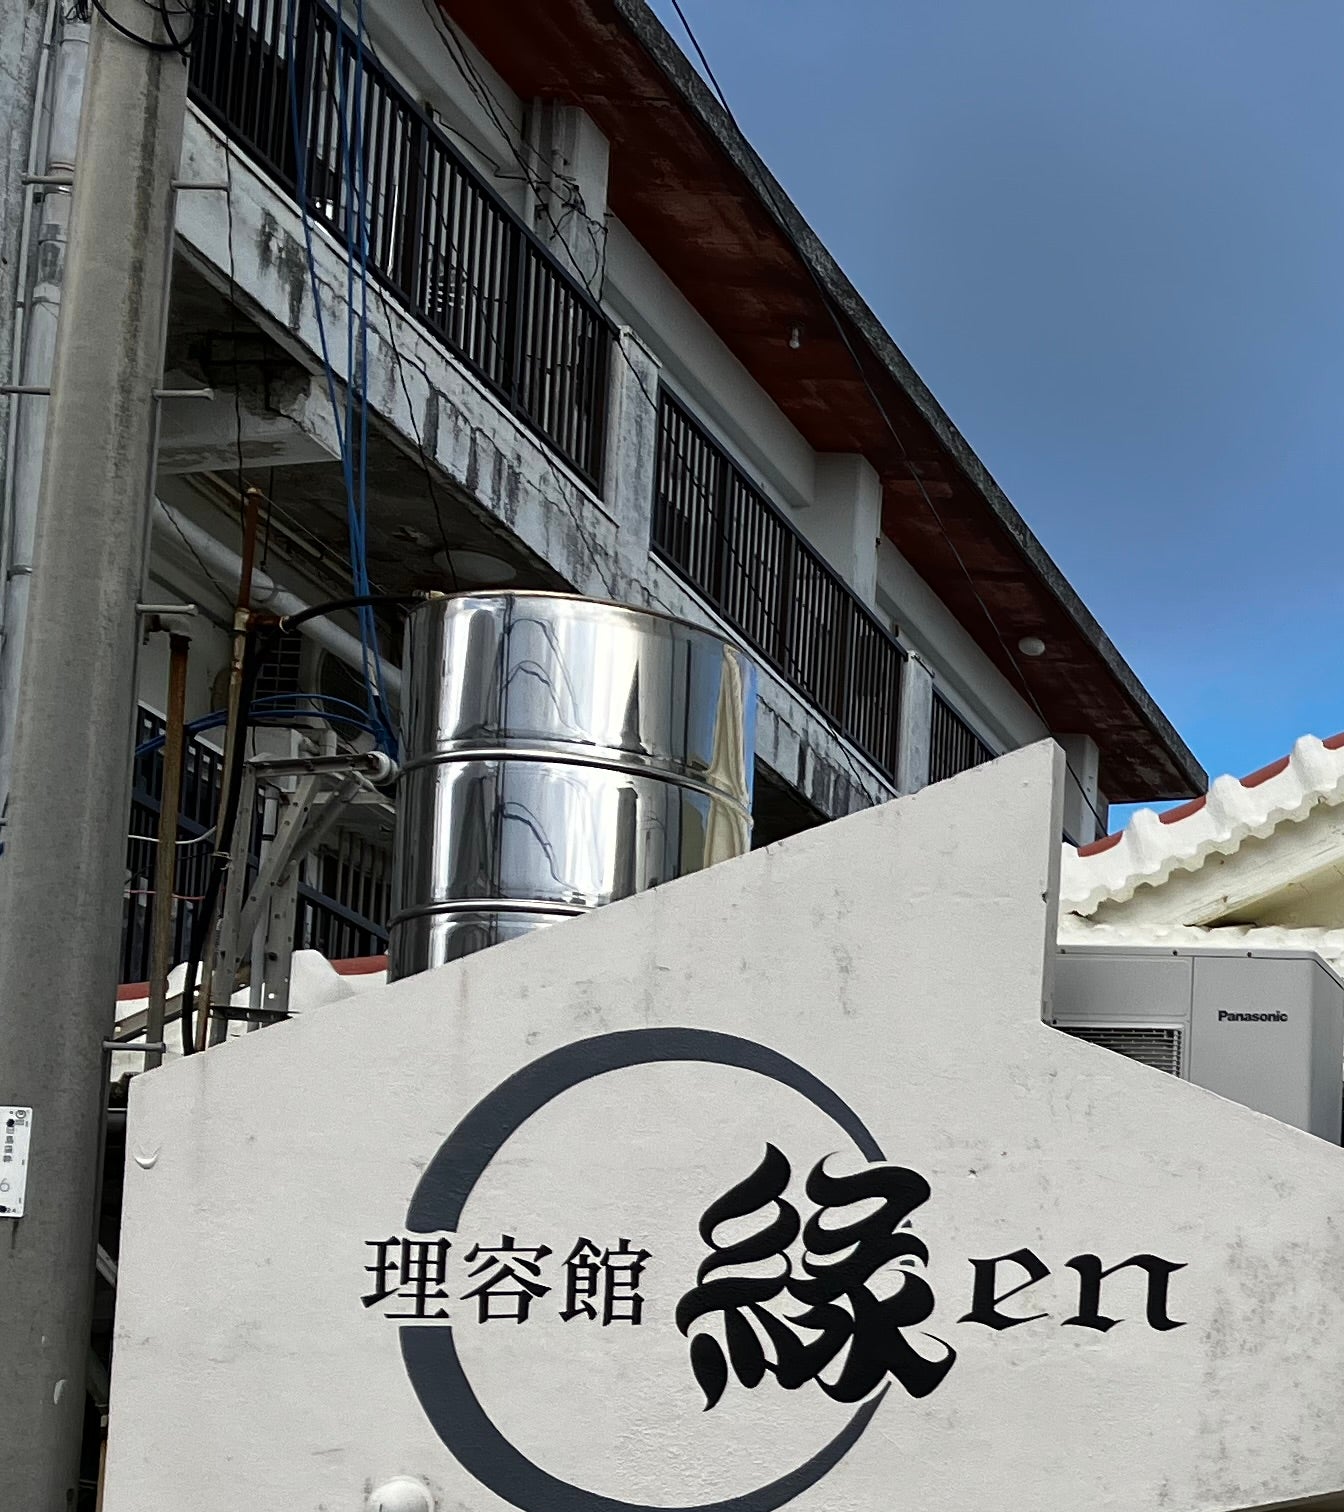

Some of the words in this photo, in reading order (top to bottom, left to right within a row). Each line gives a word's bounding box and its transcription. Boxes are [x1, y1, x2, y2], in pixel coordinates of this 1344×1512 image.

[1218, 1009, 1288, 1022] Panasonic
[361, 1234, 652, 1327] 理容館
[956, 1244, 1189, 1333] en
